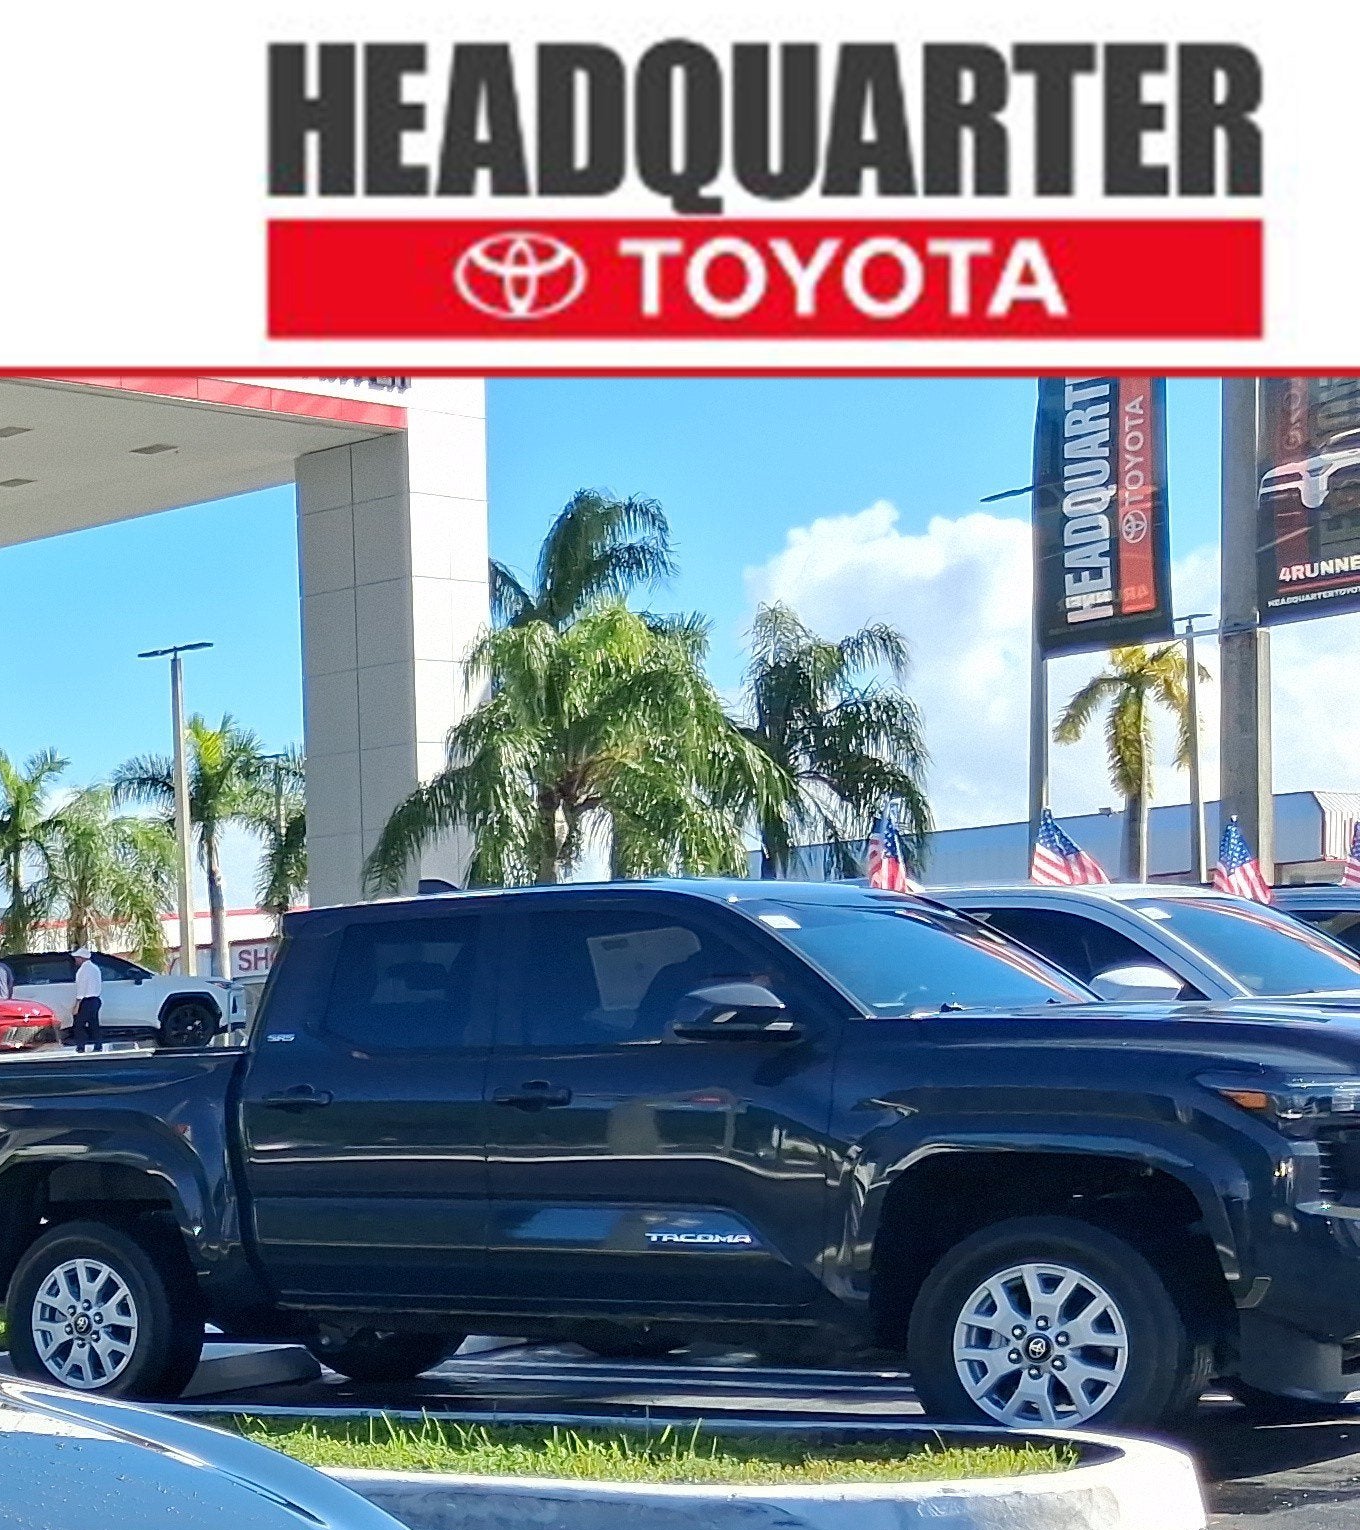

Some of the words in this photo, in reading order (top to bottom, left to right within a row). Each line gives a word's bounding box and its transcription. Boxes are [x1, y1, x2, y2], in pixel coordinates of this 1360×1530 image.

[1124, 394, 1144, 507] TOYOTA
[1062, 377, 1117, 624] HEADQUART
[238, 947, 274, 971] SH
[644, 1232, 752, 1244] TACOMA
